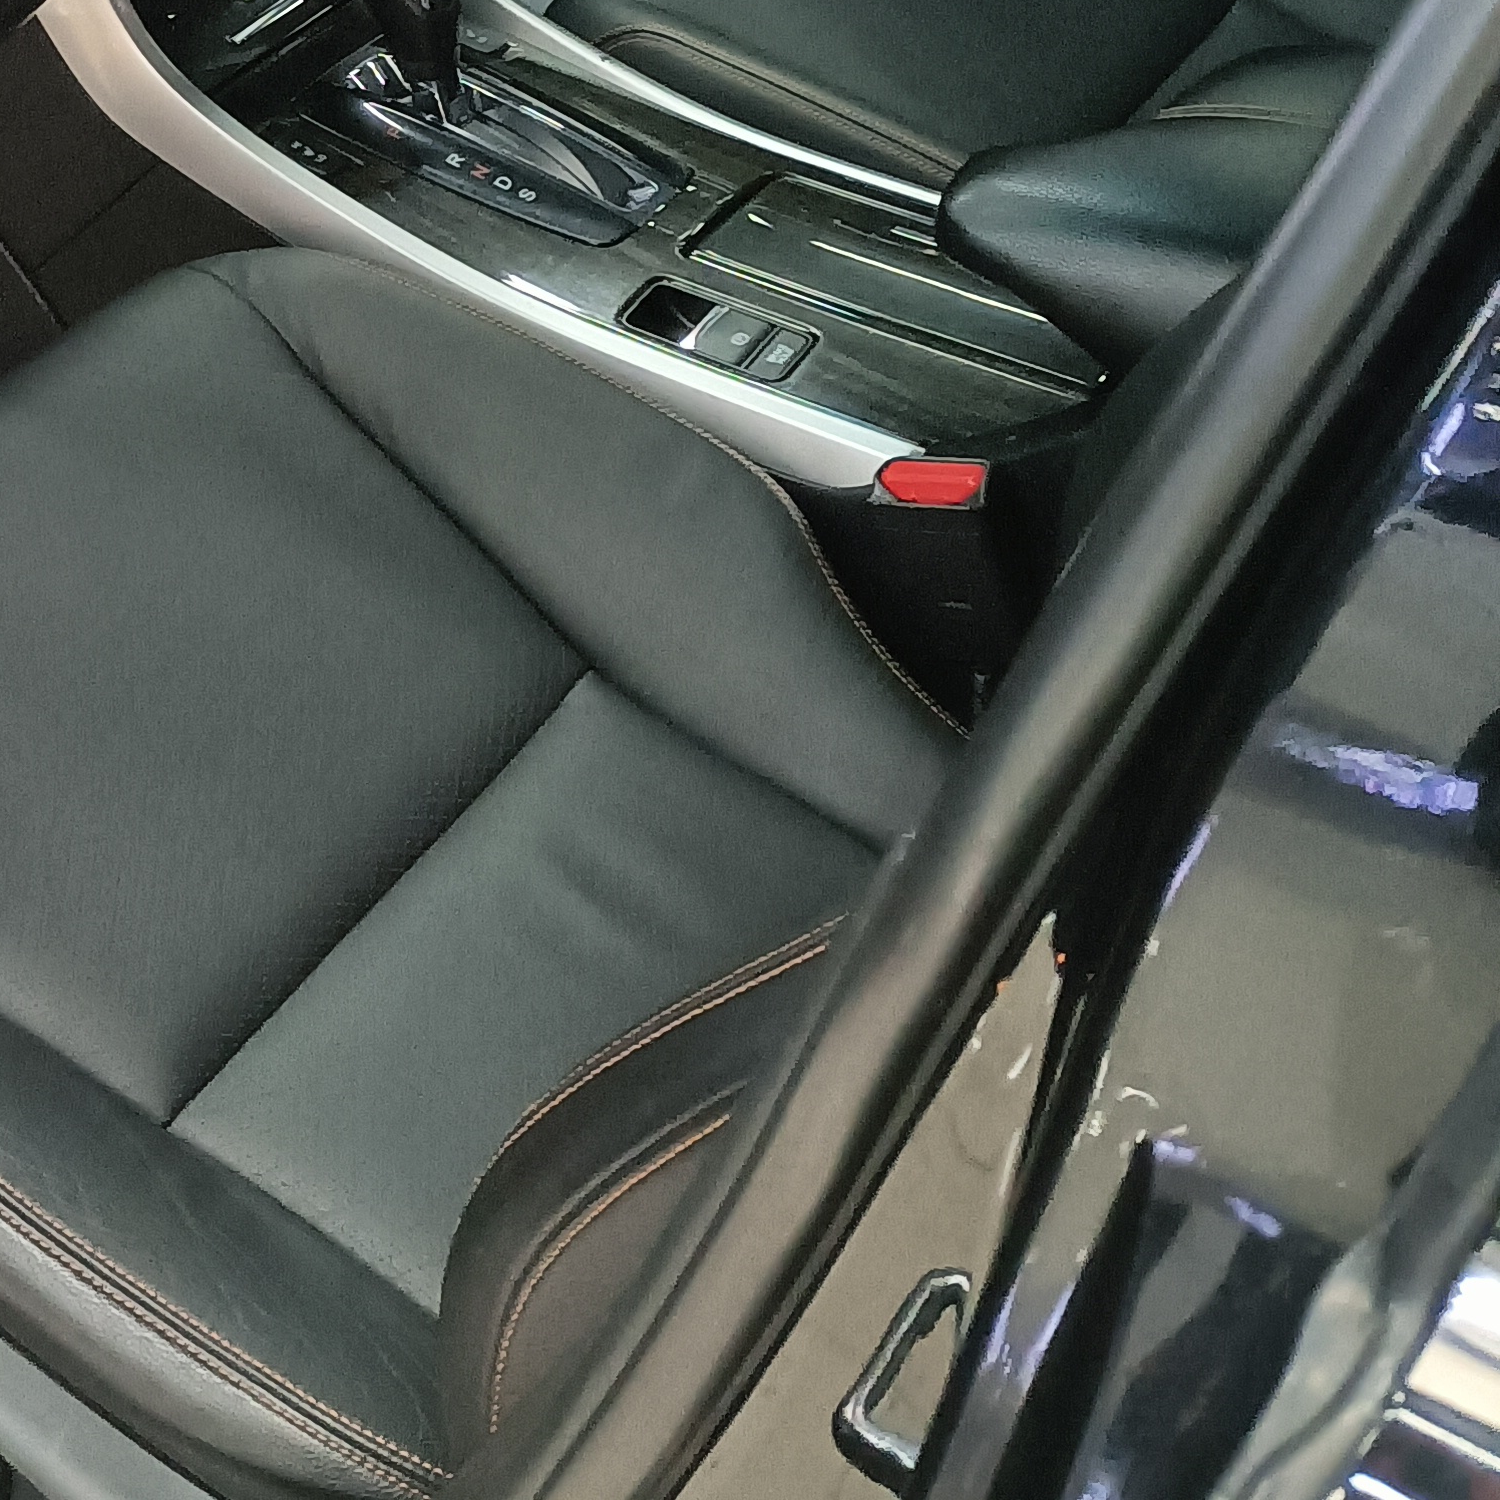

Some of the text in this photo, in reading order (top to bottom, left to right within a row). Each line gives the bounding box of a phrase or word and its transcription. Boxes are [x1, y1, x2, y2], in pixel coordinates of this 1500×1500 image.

[444, 152, 466, 169] R
[470, 162, 491, 180] N
[492, 175, 514, 192] D
[518, 187, 538, 203] S
